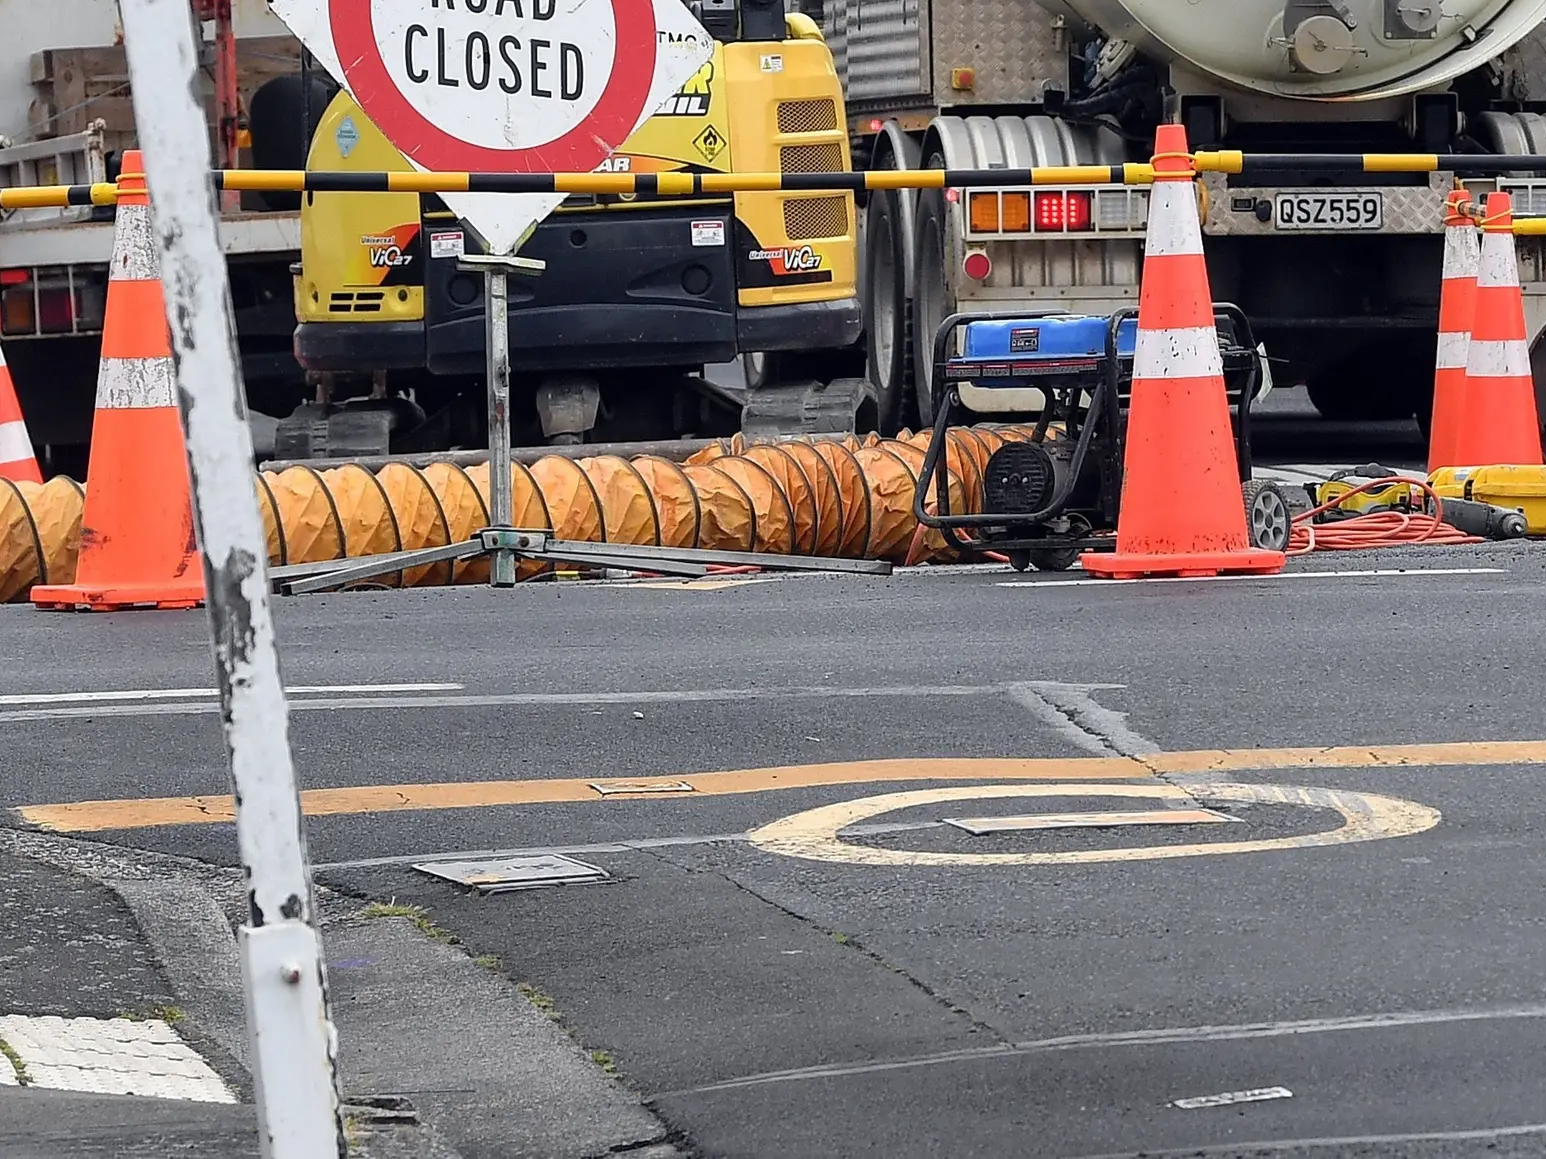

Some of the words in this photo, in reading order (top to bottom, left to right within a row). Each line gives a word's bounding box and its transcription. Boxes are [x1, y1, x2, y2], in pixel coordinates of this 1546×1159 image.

[405, 23, 584, 101] CLOSED
[1280, 198, 1378, 224] QSZ559
[360, 235, 396, 245] Universal
[748, 249, 784, 259] Universal
